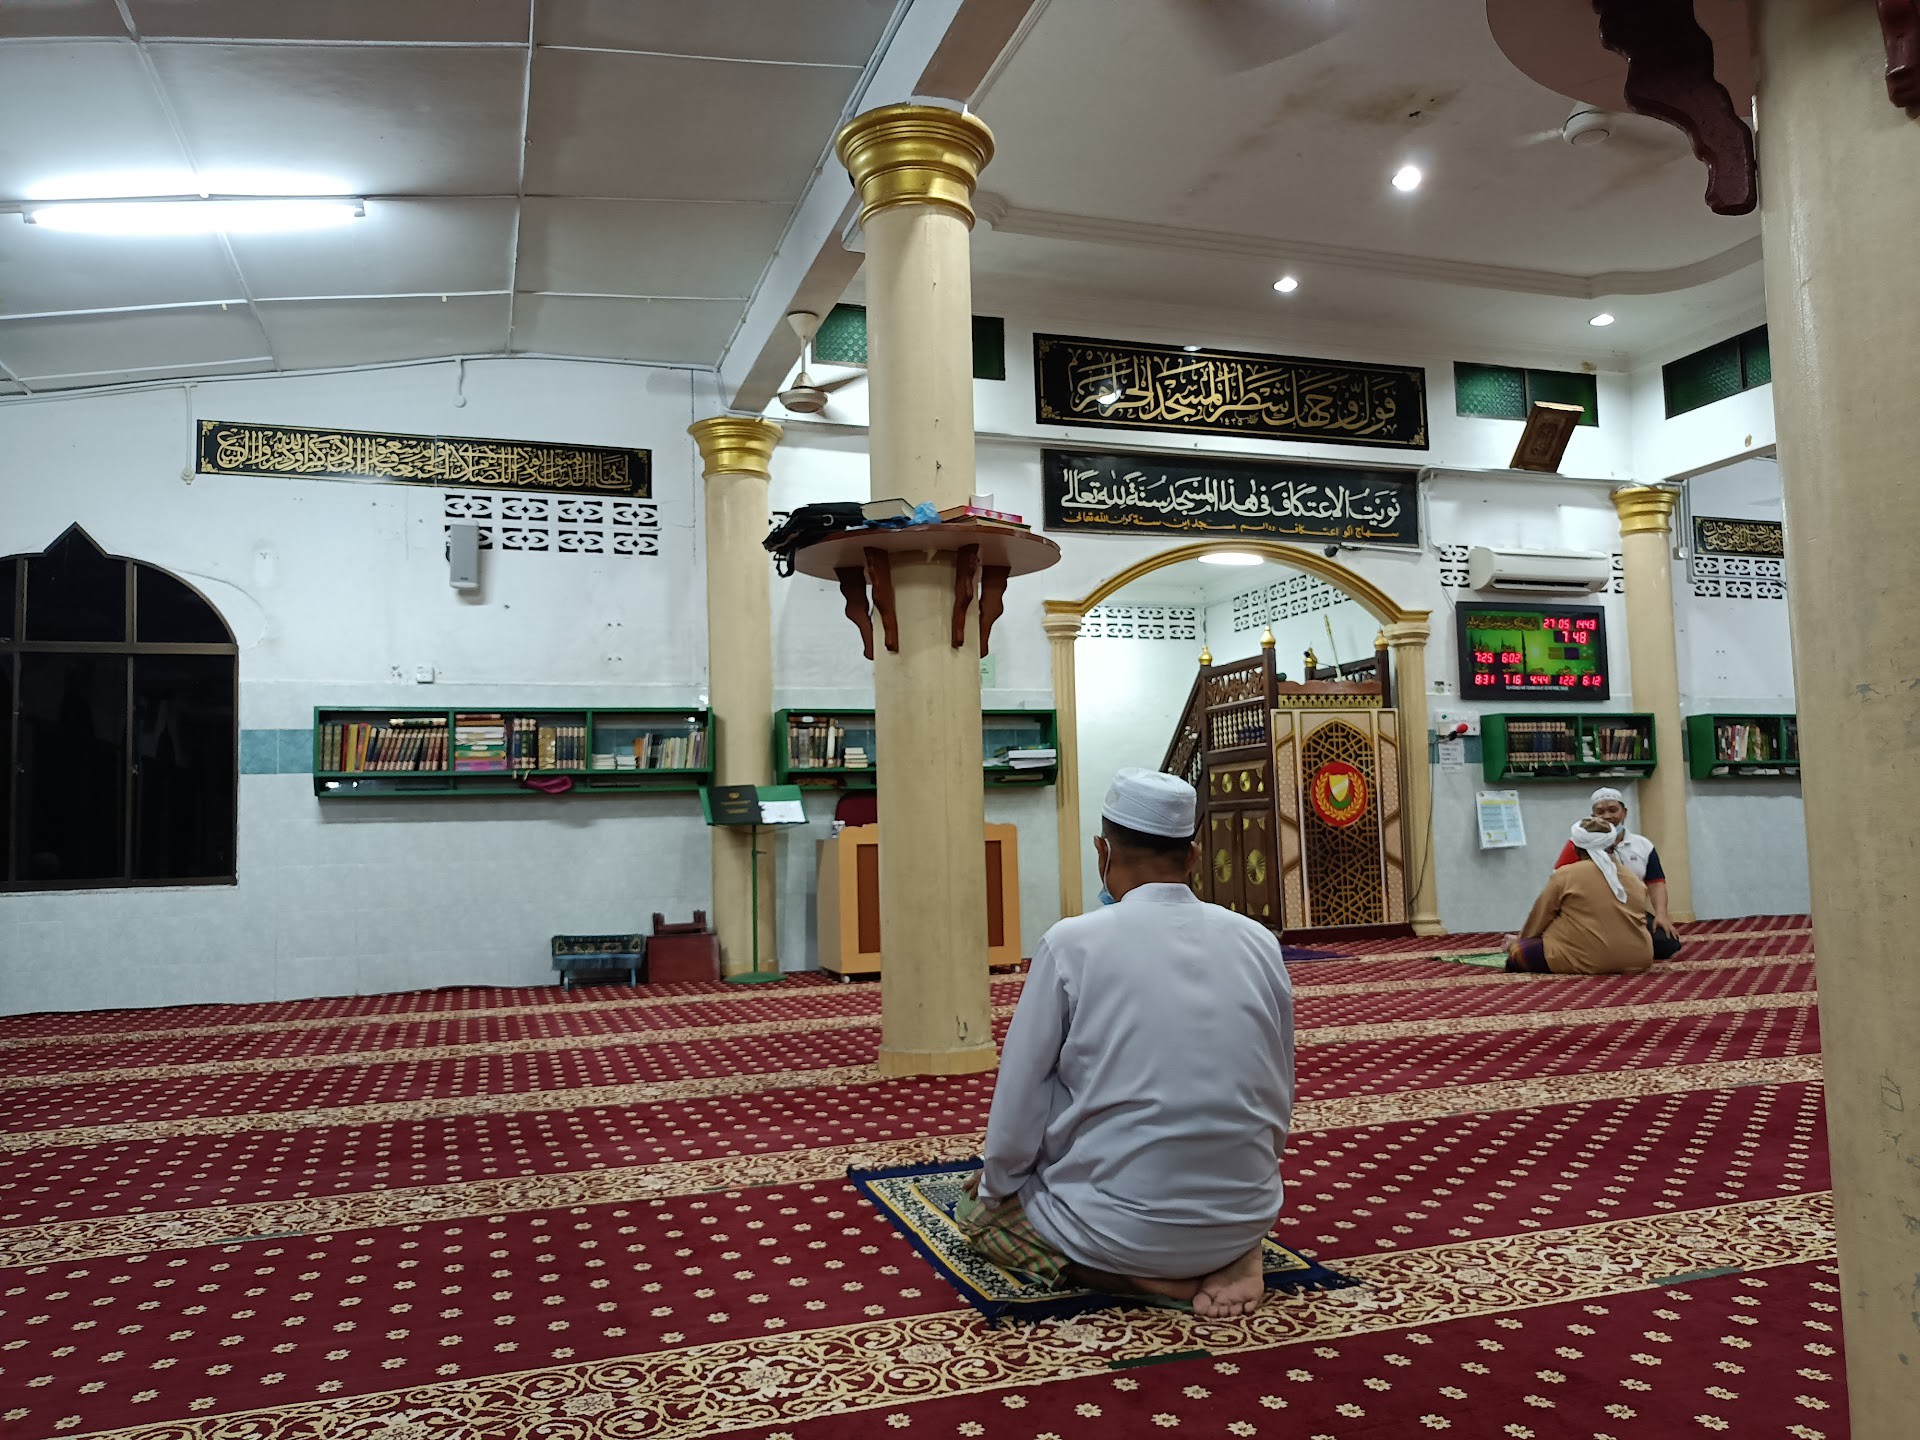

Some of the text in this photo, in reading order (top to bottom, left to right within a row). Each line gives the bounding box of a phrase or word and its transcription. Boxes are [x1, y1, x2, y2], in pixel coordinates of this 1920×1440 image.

[1543, 618, 1556, 630] 27
[1558, 618, 1571, 630] 05
[1576, 619, 1597, 630] 1443
